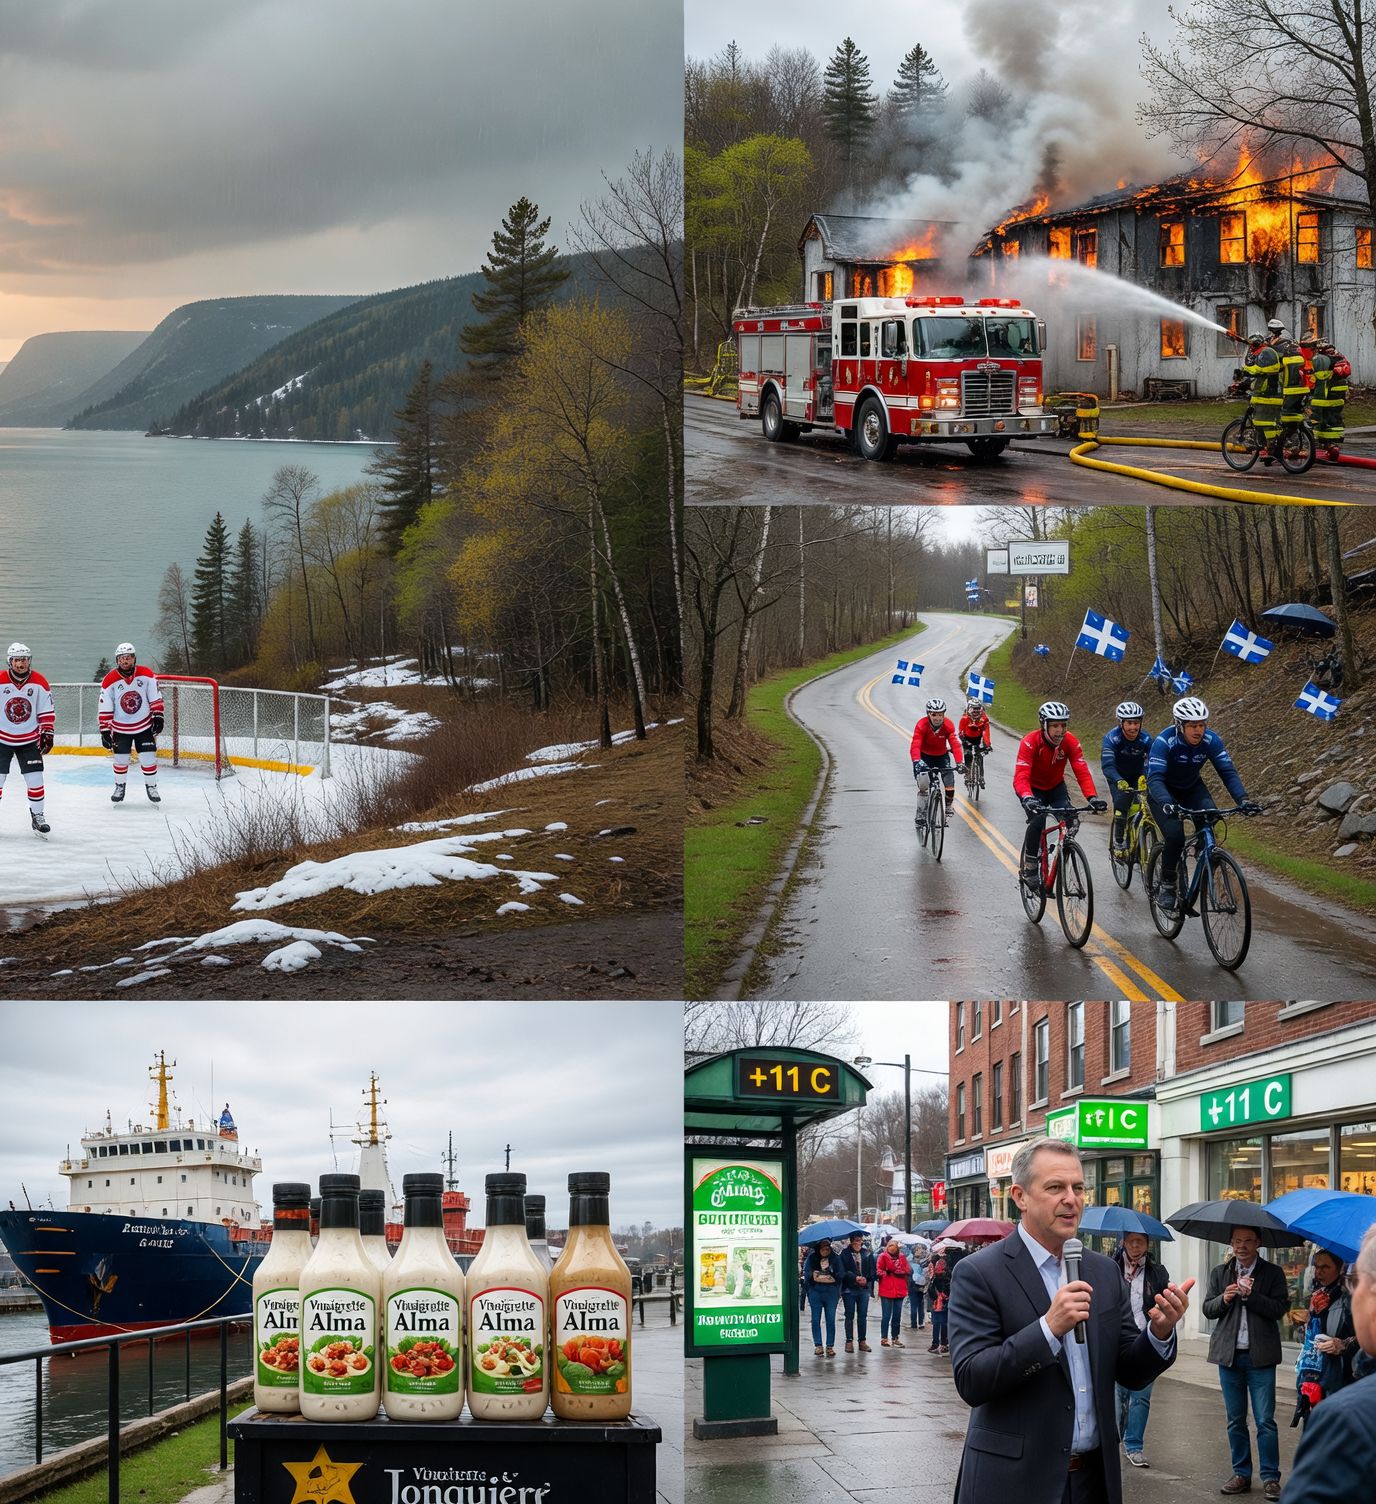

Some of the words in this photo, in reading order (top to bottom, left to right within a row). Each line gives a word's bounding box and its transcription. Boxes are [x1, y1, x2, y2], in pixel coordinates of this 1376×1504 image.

[749, 1064, 799, 1092] +11
[810, 1067, 831, 1094] C
[1208, 1087, 1251, 1125] +11
[1263, 1081, 1283, 1115] C
[263, 1311, 299, 1329] Alm
[309, 1312, 366, 1331] Alma
[394, 1312, 450, 1331] Alma
[478, 1312, 536, 1331] Alma
[563, 1311, 620, 1331] Alma
